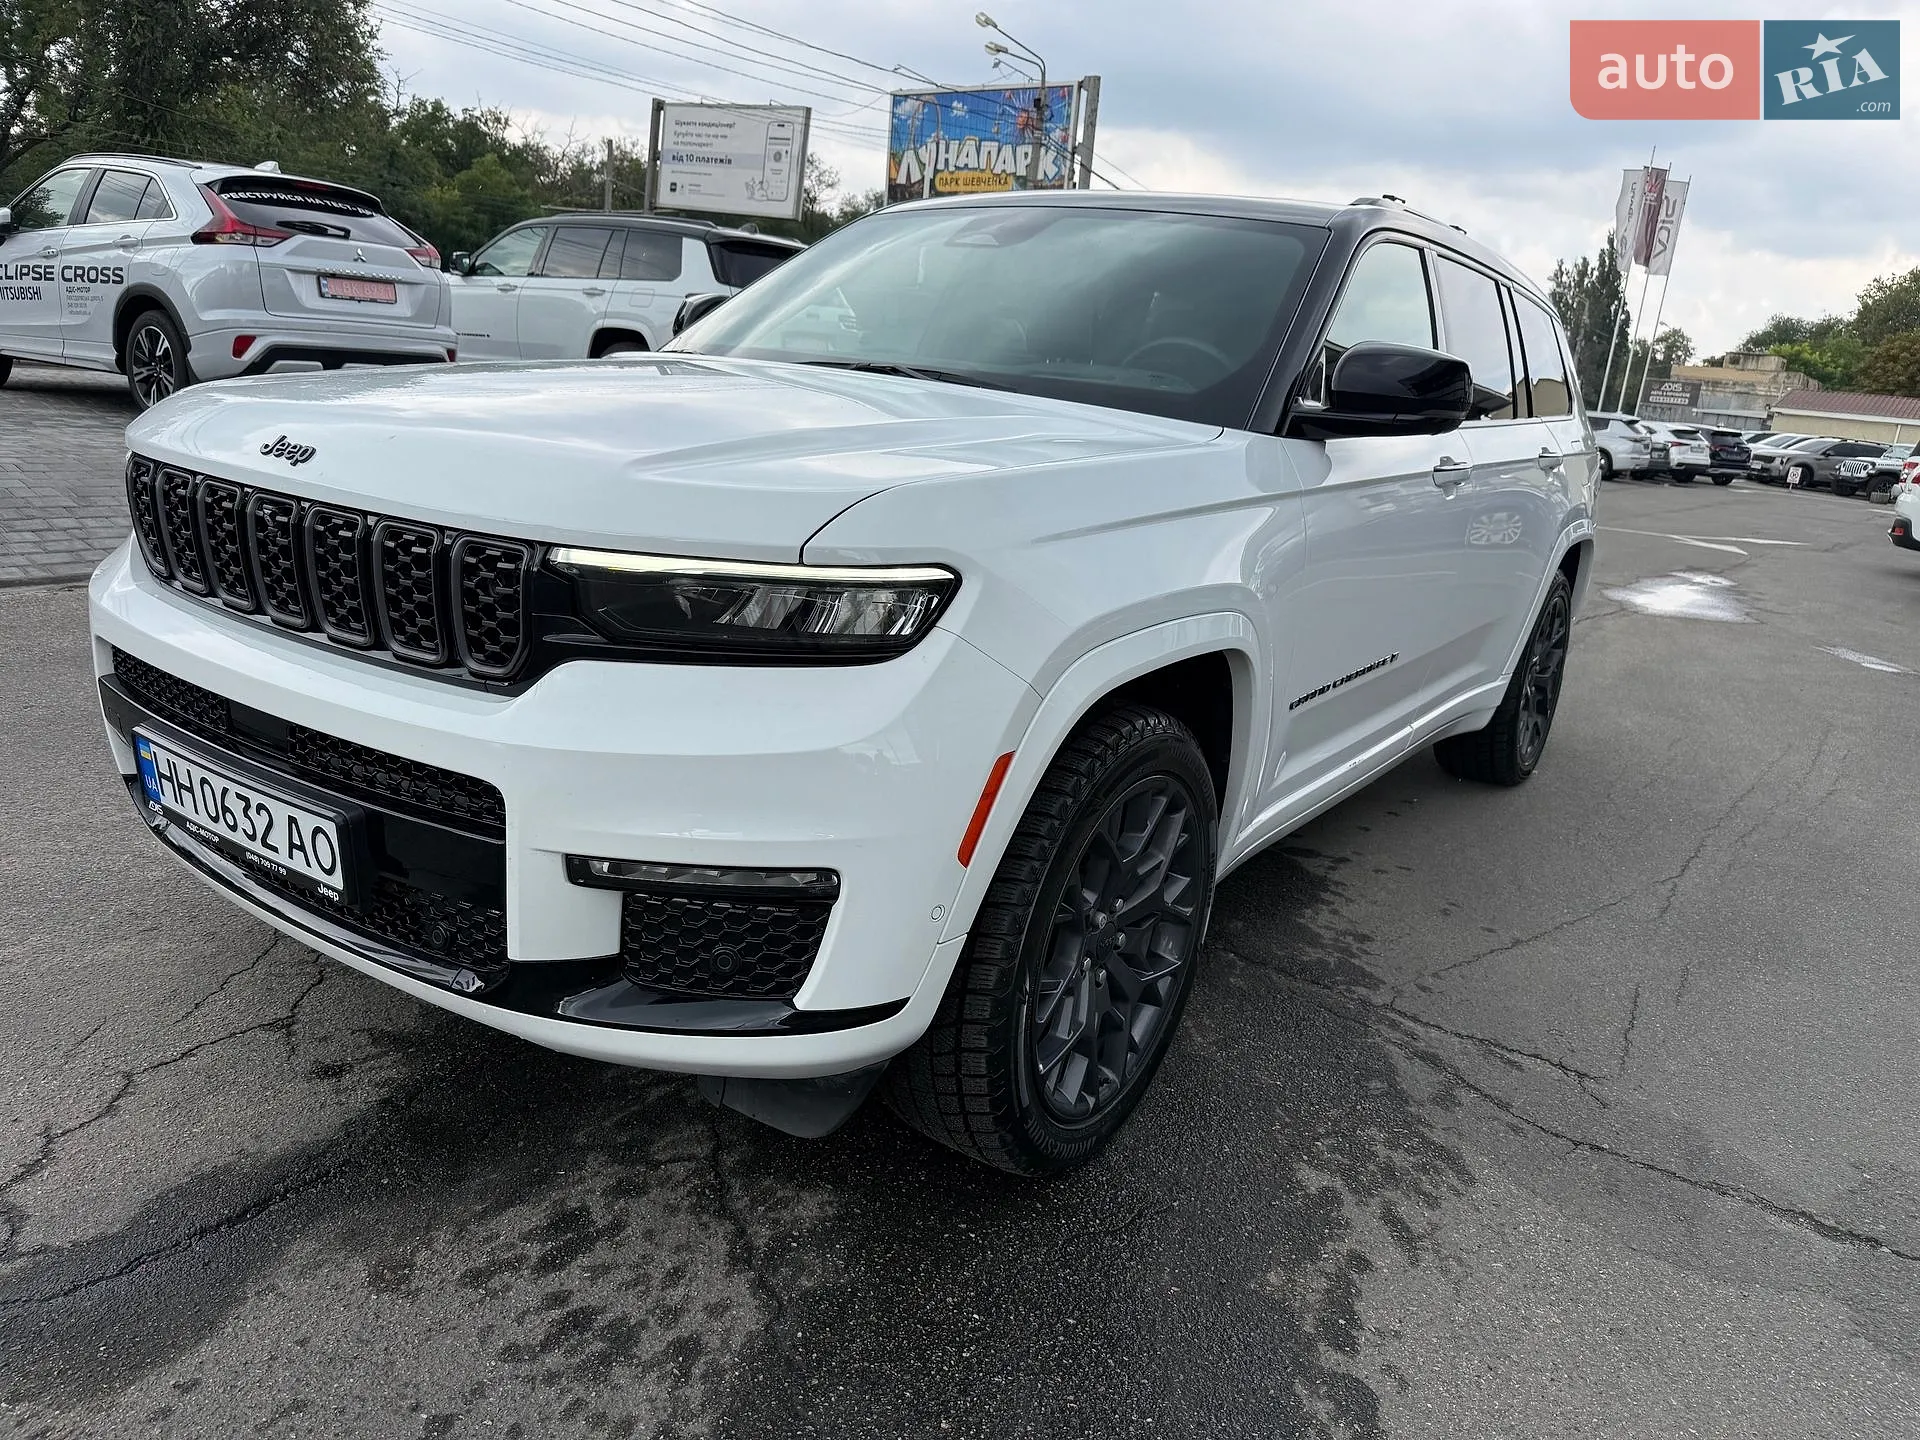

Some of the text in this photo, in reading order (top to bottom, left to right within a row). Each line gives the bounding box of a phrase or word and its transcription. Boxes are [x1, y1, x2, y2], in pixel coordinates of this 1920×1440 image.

[672, 152, 732, 165] від 10 платежів
[896, 137, 1061, 199] ЛУНАПАРК
[939, 173, 1009, 187] ПАРК ШЕВЧЕНКА
[305, 197, 324, 206] НА
[61, 265, 124, 284] CROSS
[260, 434, 316, 467] Jeep
[144, 774, 159, 793] UA
[153, 750, 338, 876] HH 0632 AO
[278, 866, 287, 876] 99
[317, 882, 339, 902] Jeep
